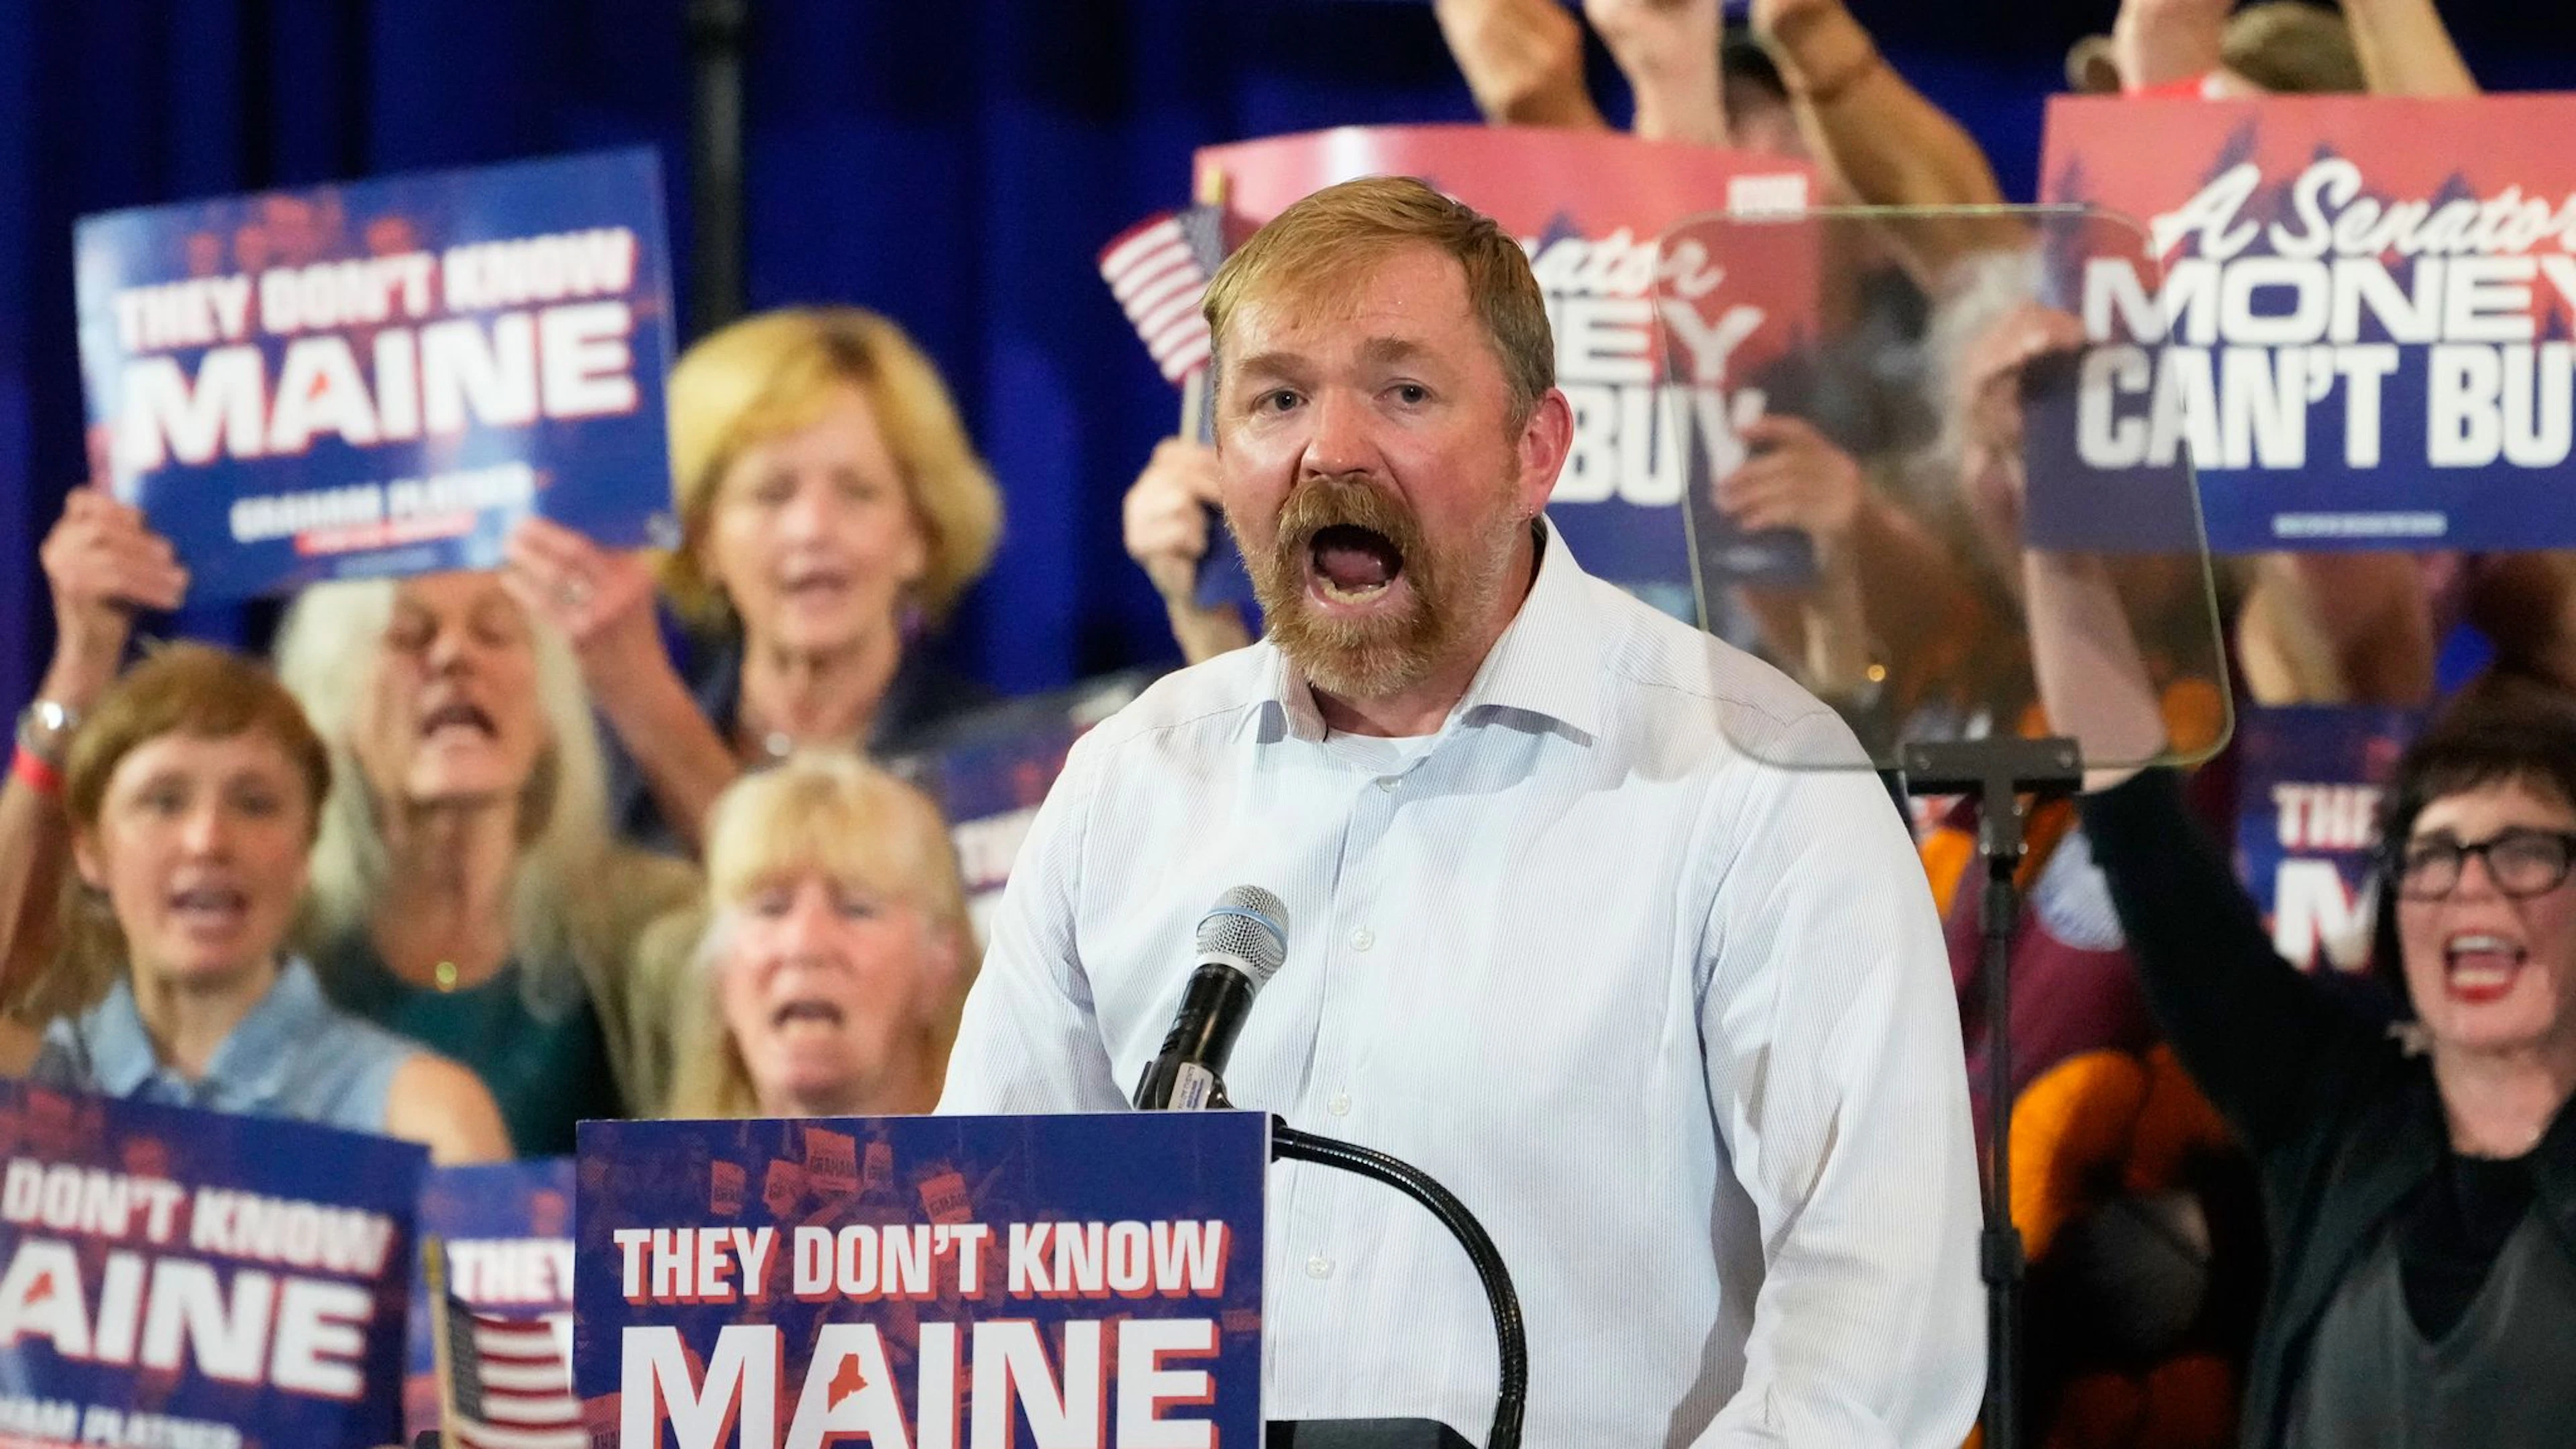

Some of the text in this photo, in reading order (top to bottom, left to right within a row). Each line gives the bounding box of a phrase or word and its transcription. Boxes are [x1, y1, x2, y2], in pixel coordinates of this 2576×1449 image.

[2148, 162, 2261, 261] A
[117, 276, 250, 350] THEY
[111, 300, 637, 476] MAINE
[2076, 341, 2575, 470] CAN'T BU
[2269, 781, 2384, 849] THE
[1, 1155, 396, 1278] DON'T KNOW
[613, 1220, 1226, 1301] THEY DON'T KNOW
[0, 1236, 374, 1400] AINE
[619, 1318, 1220, 1449] MAINE
